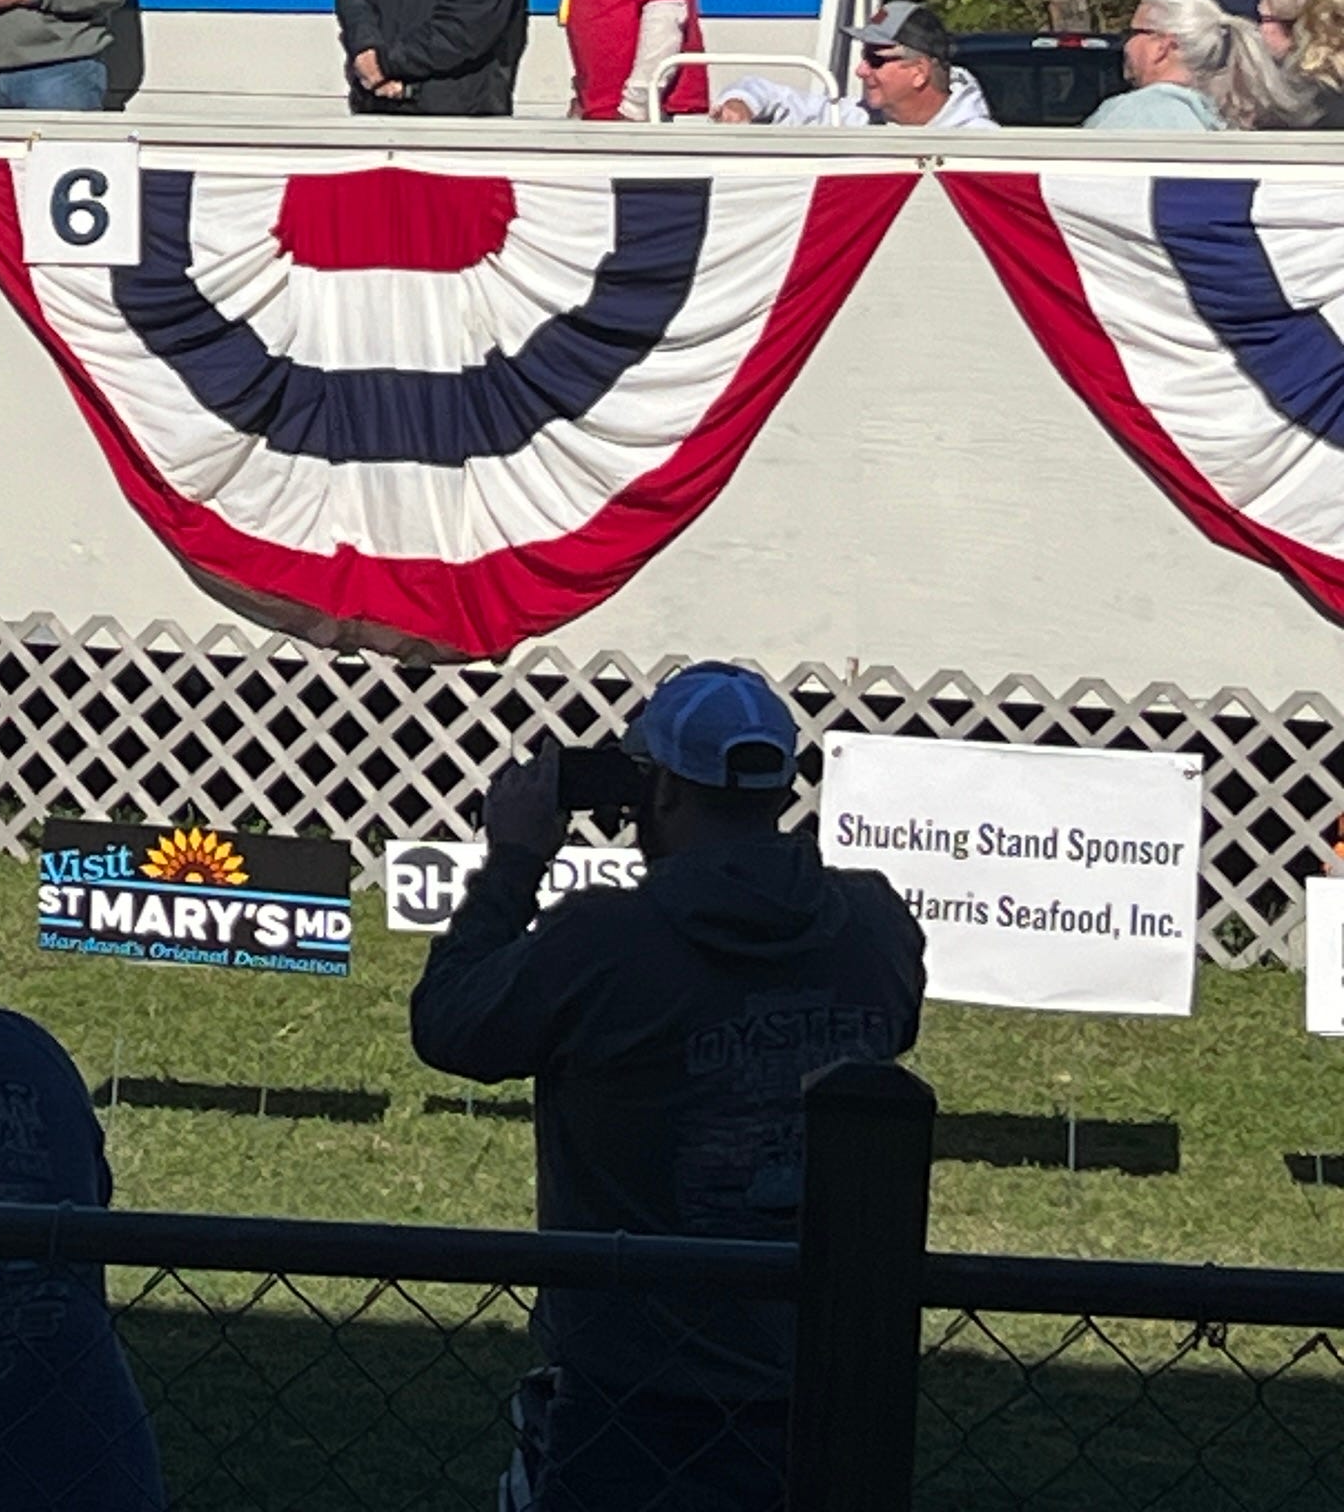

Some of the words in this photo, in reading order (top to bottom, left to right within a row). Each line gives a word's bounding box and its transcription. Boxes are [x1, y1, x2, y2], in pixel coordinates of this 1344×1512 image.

[49, 167, 110, 246] 6
[40, 844, 135, 885] Visit
[836, 812, 970, 861] Shucking
[976, 823, 1058, 861] Stand
[1065, 828, 1185, 869] Sponsor
[38, 885, 84, 916] ST
[89, 889, 291, 948] MARY'S
[294, 908, 352, 941] MD
[905, 888, 989, 926] Harris
[995, 895, 1121, 940] Seafood,
[1130, 904, 1183, 939] Inc.
[38, 931, 144, 957] Maryland's
[149, 941, 229, 966] Original
[234, 949, 348, 978] Destination
